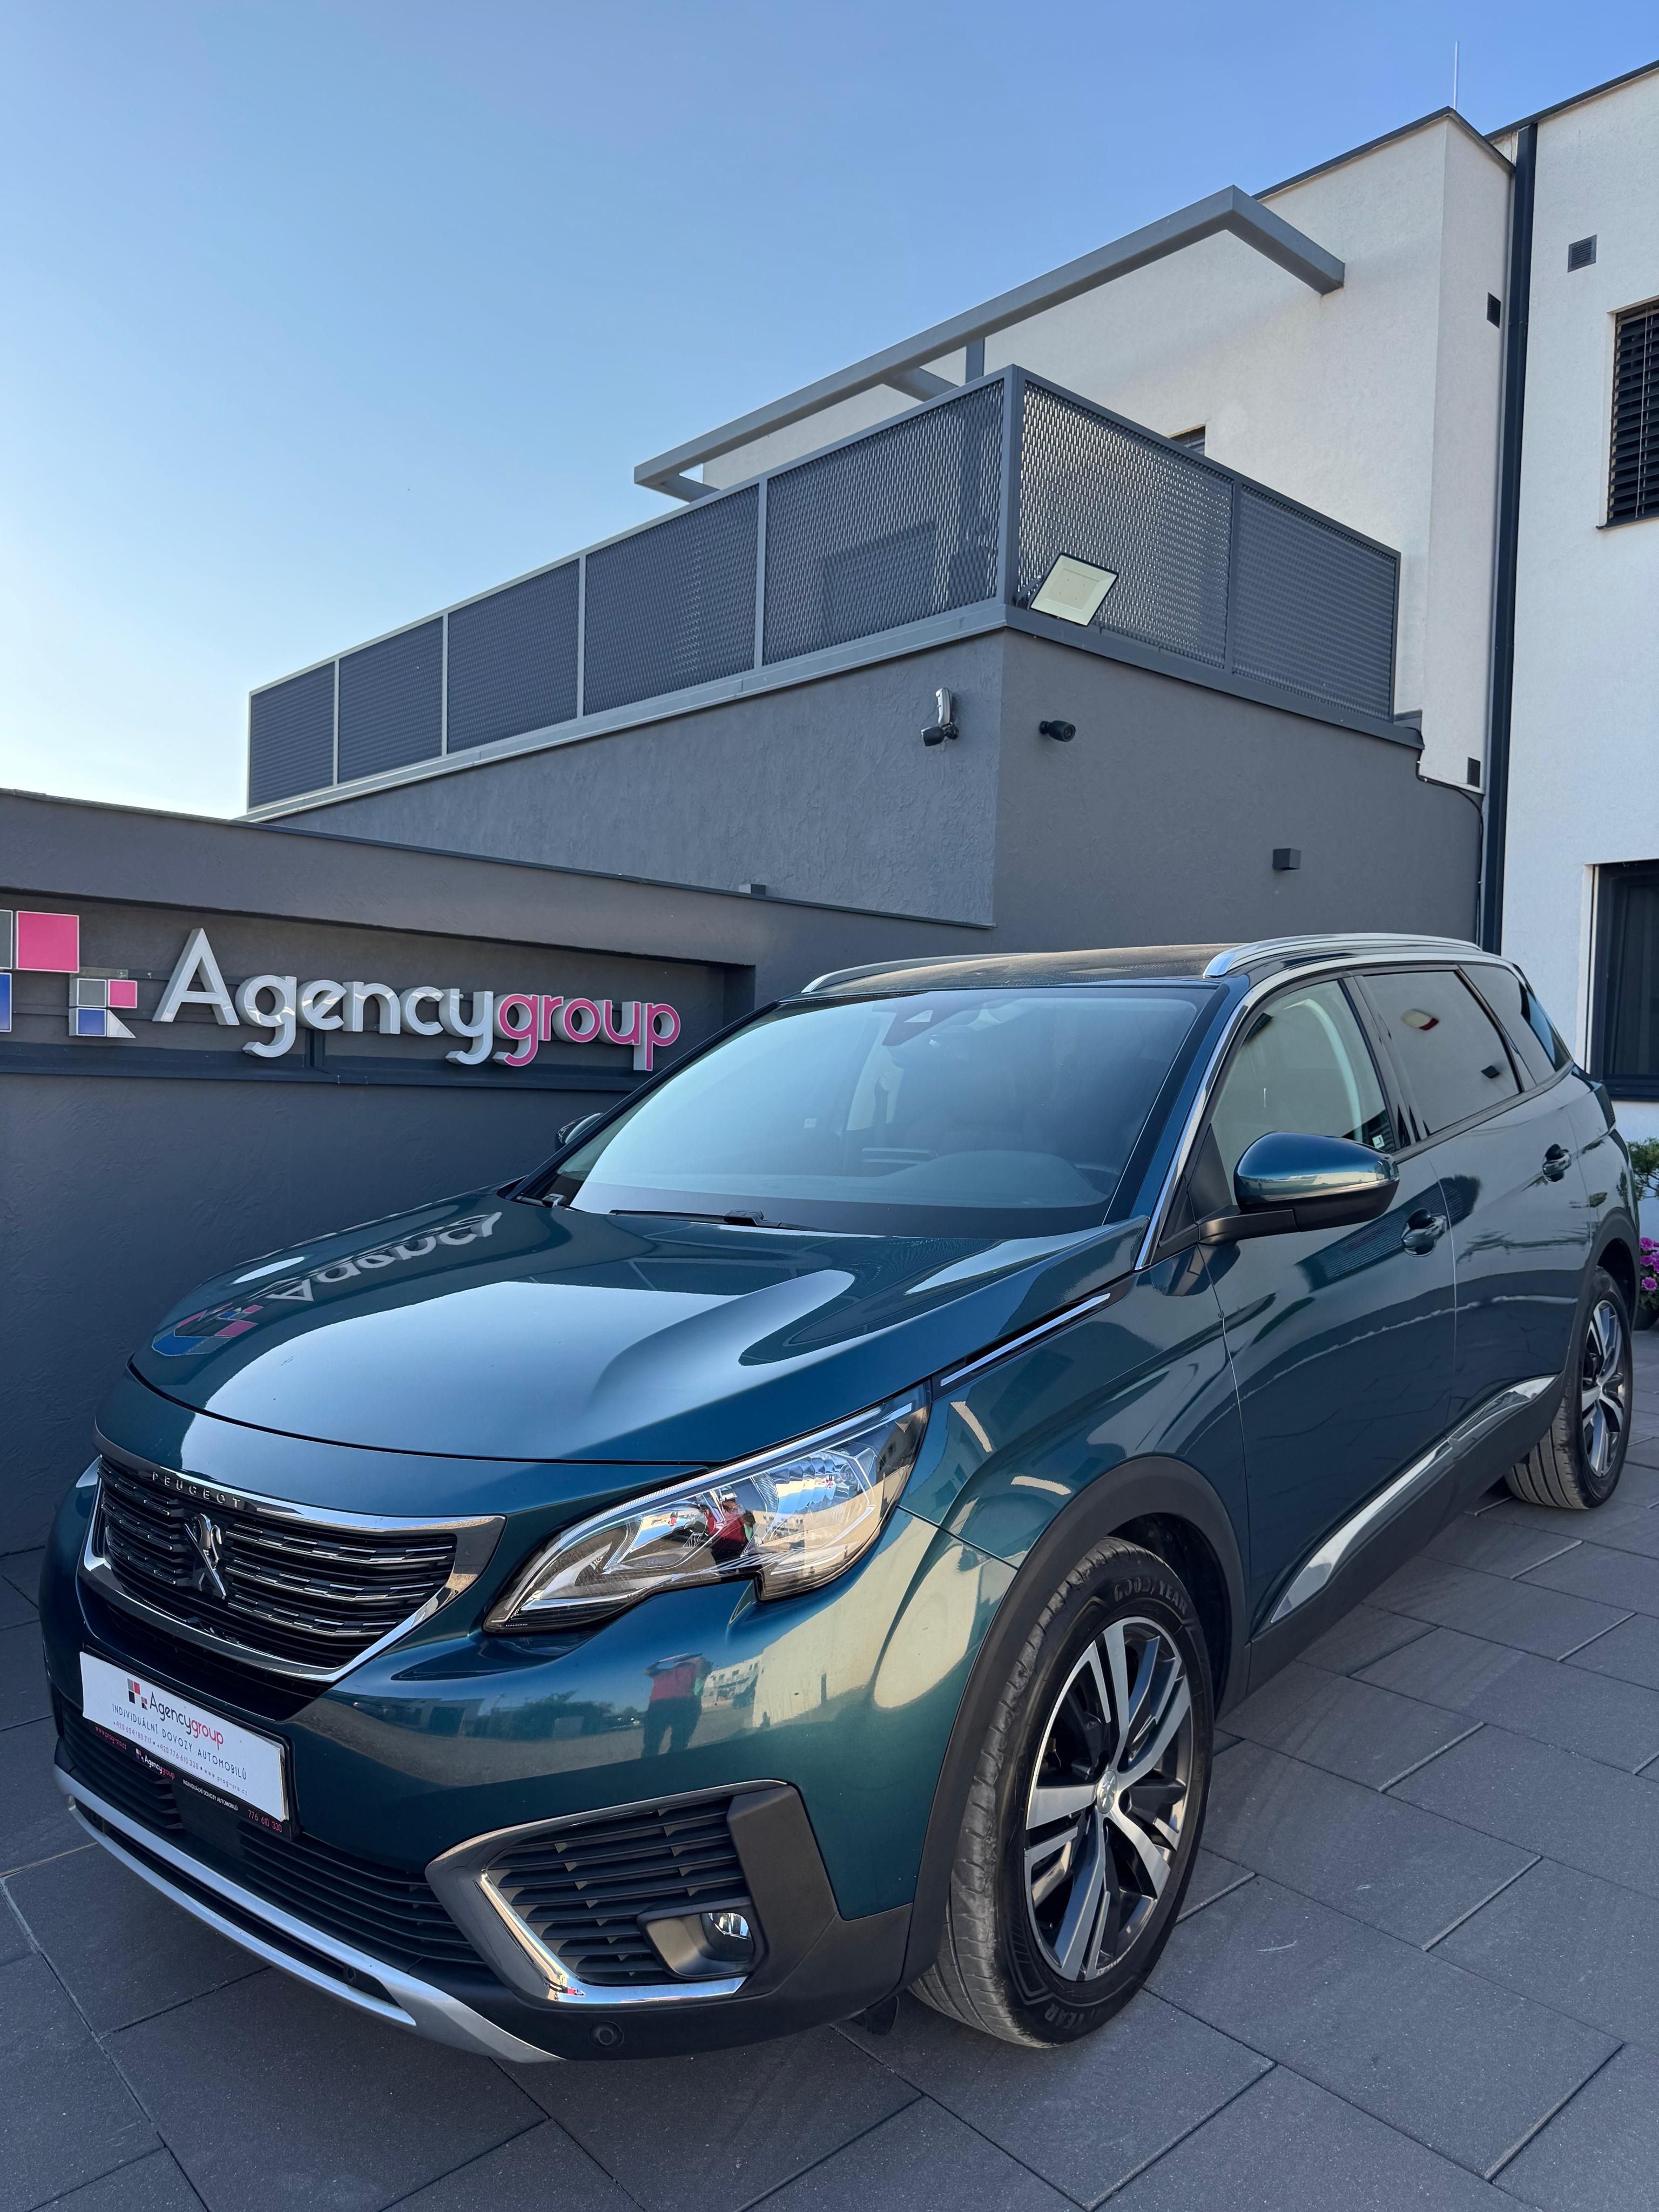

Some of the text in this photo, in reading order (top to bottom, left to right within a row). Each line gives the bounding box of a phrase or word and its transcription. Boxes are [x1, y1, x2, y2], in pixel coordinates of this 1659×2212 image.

[152, 927, 681, 1071] Agencygroup
[152, 1471, 241, 1508] PEUGEOT
[112, 1703, 247, 1780] INDIVIDUÁLNÍ DOVOZY AUTOMOBILŮ
[150, 1691, 224, 1750] Agencygroup
[144, 1755, 175, 1780] Agencygroup
[203, 1789, 217, 1800] DOVOZY
[247, 1809, 259, 1822] 776
[261, 1816, 269, 1827] 610
[272, 1821, 282, 1832] 330
[170, 1749, 179, 1759] 776
[190, 1759, 199, 1770] 330
